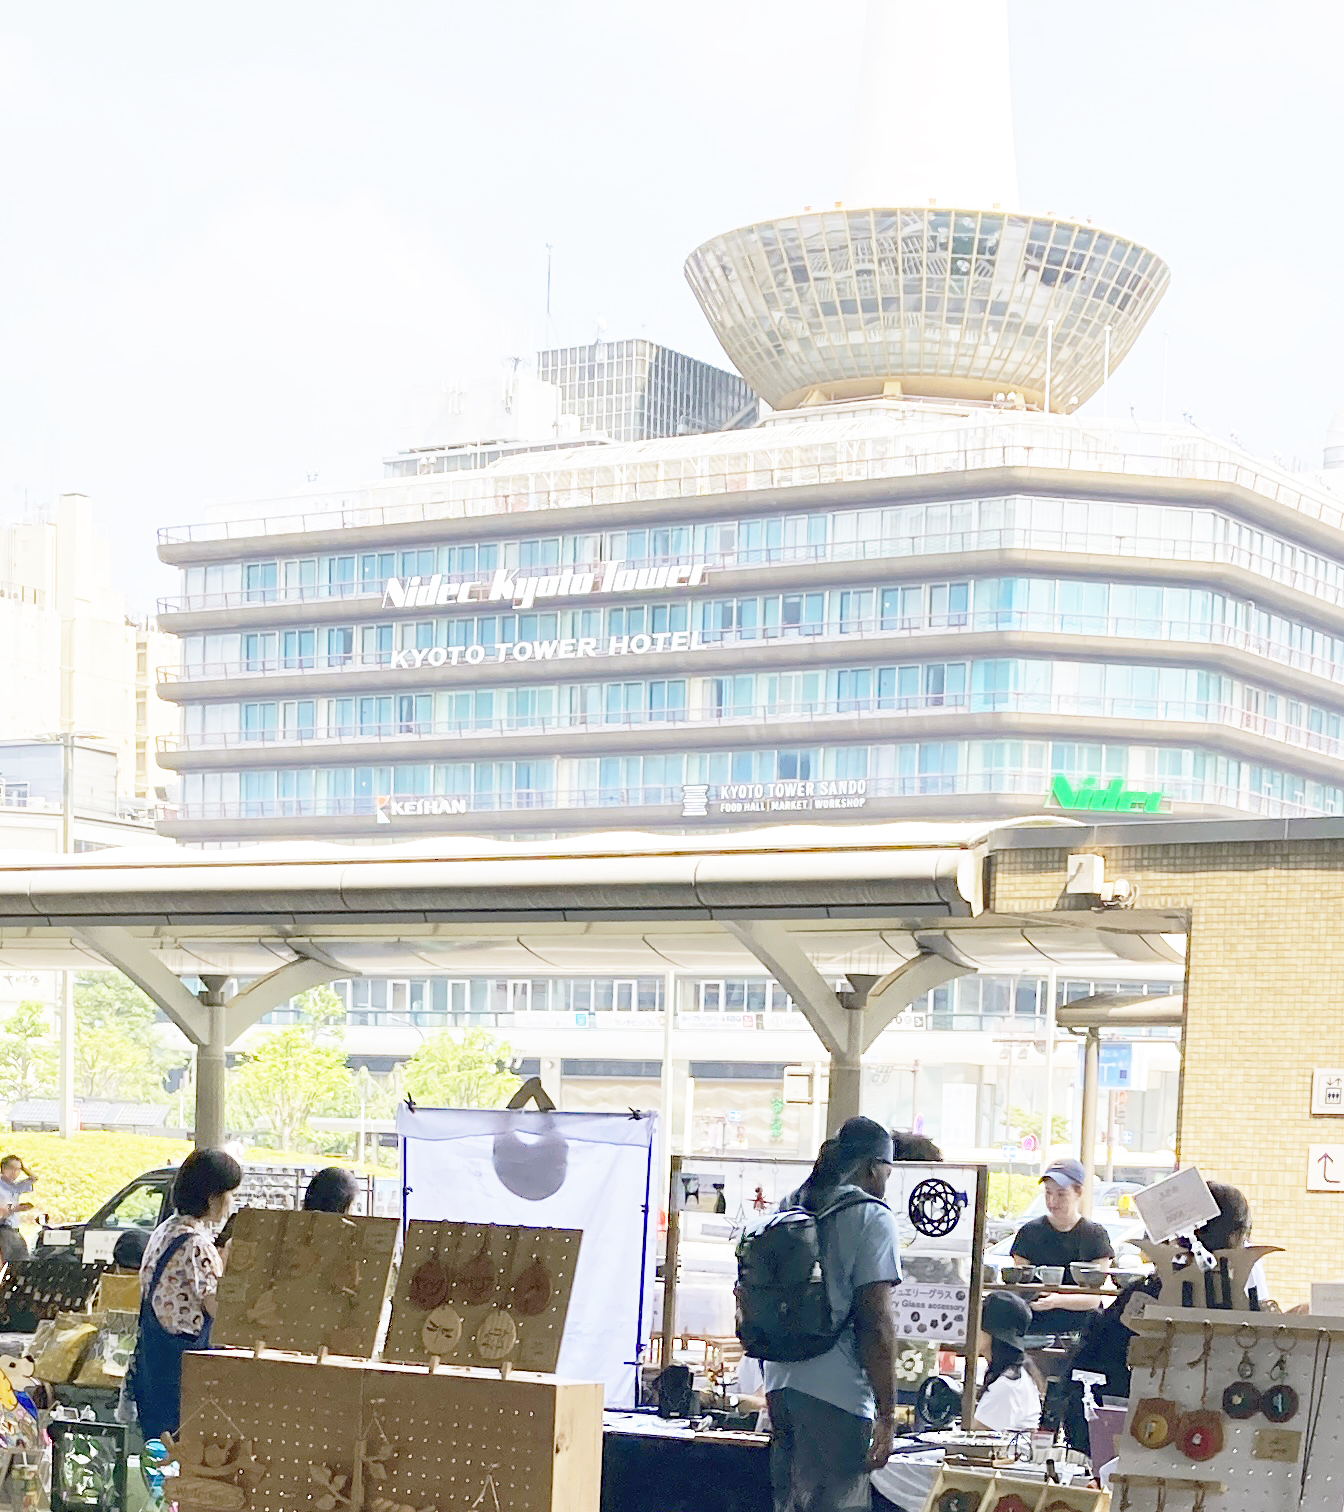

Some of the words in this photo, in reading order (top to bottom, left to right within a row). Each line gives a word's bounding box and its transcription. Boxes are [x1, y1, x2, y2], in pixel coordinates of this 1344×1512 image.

[382, 574, 482, 608] Nidec
[489, 567, 595, 609] Kyoto
[601, 559, 713, 593] Tower
[390, 645, 485, 669] KYOTO
[495, 637, 597, 663] TOWER
[609, 630, 708, 656] HOTEL
[719, 801, 743, 812] FOOD
[744, 801, 766, 811] HALL
[770, 799, 809, 810] MARKET
[814, 798, 866, 809] WORKSHOP
[720, 784, 765, 801] KYOTO
[768, 782, 815, 798] TOWER
[818, 779, 867, 796] SANDO
[1047, 773, 1164, 813] Nidec
[901, 1299, 926, 1309] Glass
[927, 1303, 966, 1313] accessory
